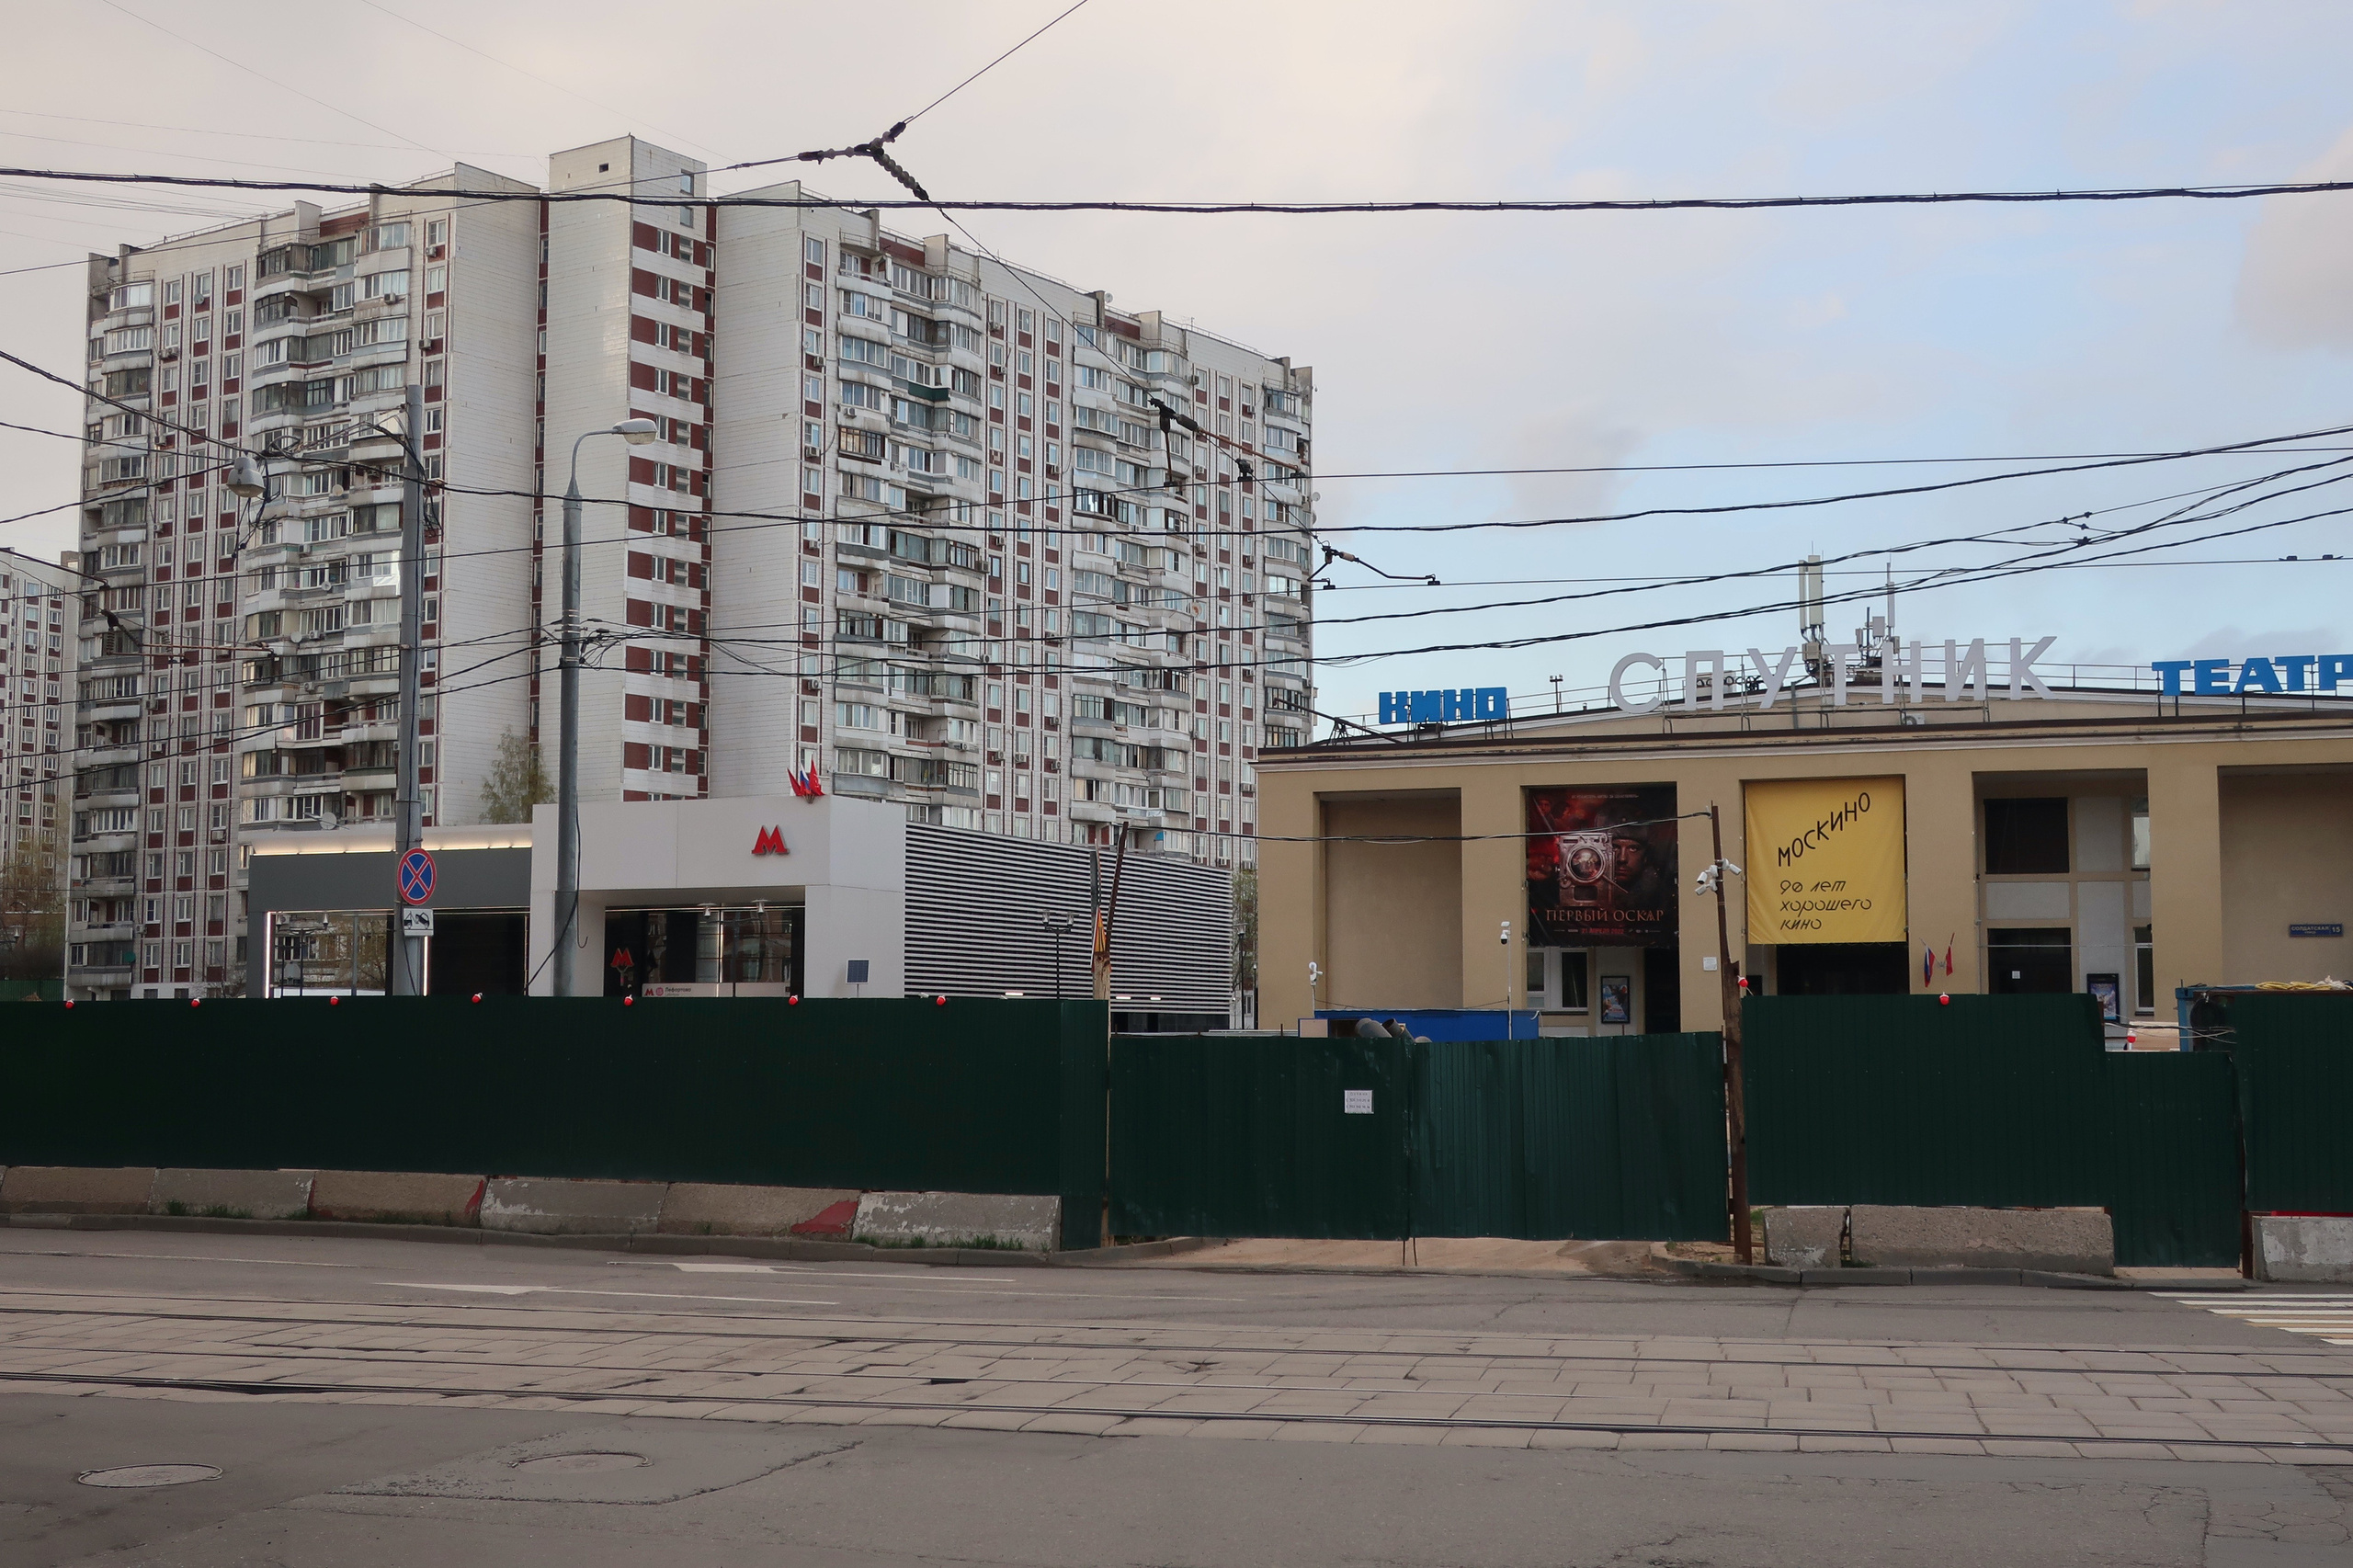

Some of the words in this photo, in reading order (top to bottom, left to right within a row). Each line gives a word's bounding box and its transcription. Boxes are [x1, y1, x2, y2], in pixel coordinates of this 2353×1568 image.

[1609, 635, 2058, 714] СПУТНИК
[2152, 653, 2353, 696] ТЕАТР
[1379, 687, 1507, 724] КИНО
[1778, 792, 1870, 867] МОСКИНО
[1779, 880, 1803, 894] 90
[1810, 881, 1847, 892] лет
[1546, 908, 1608, 922] ПЕРВЫЙ
[1613, 909, 1665, 922] ОСКАР
[1779, 898, 1872, 917] хорошего
[1779, 918, 1822, 930] кино
